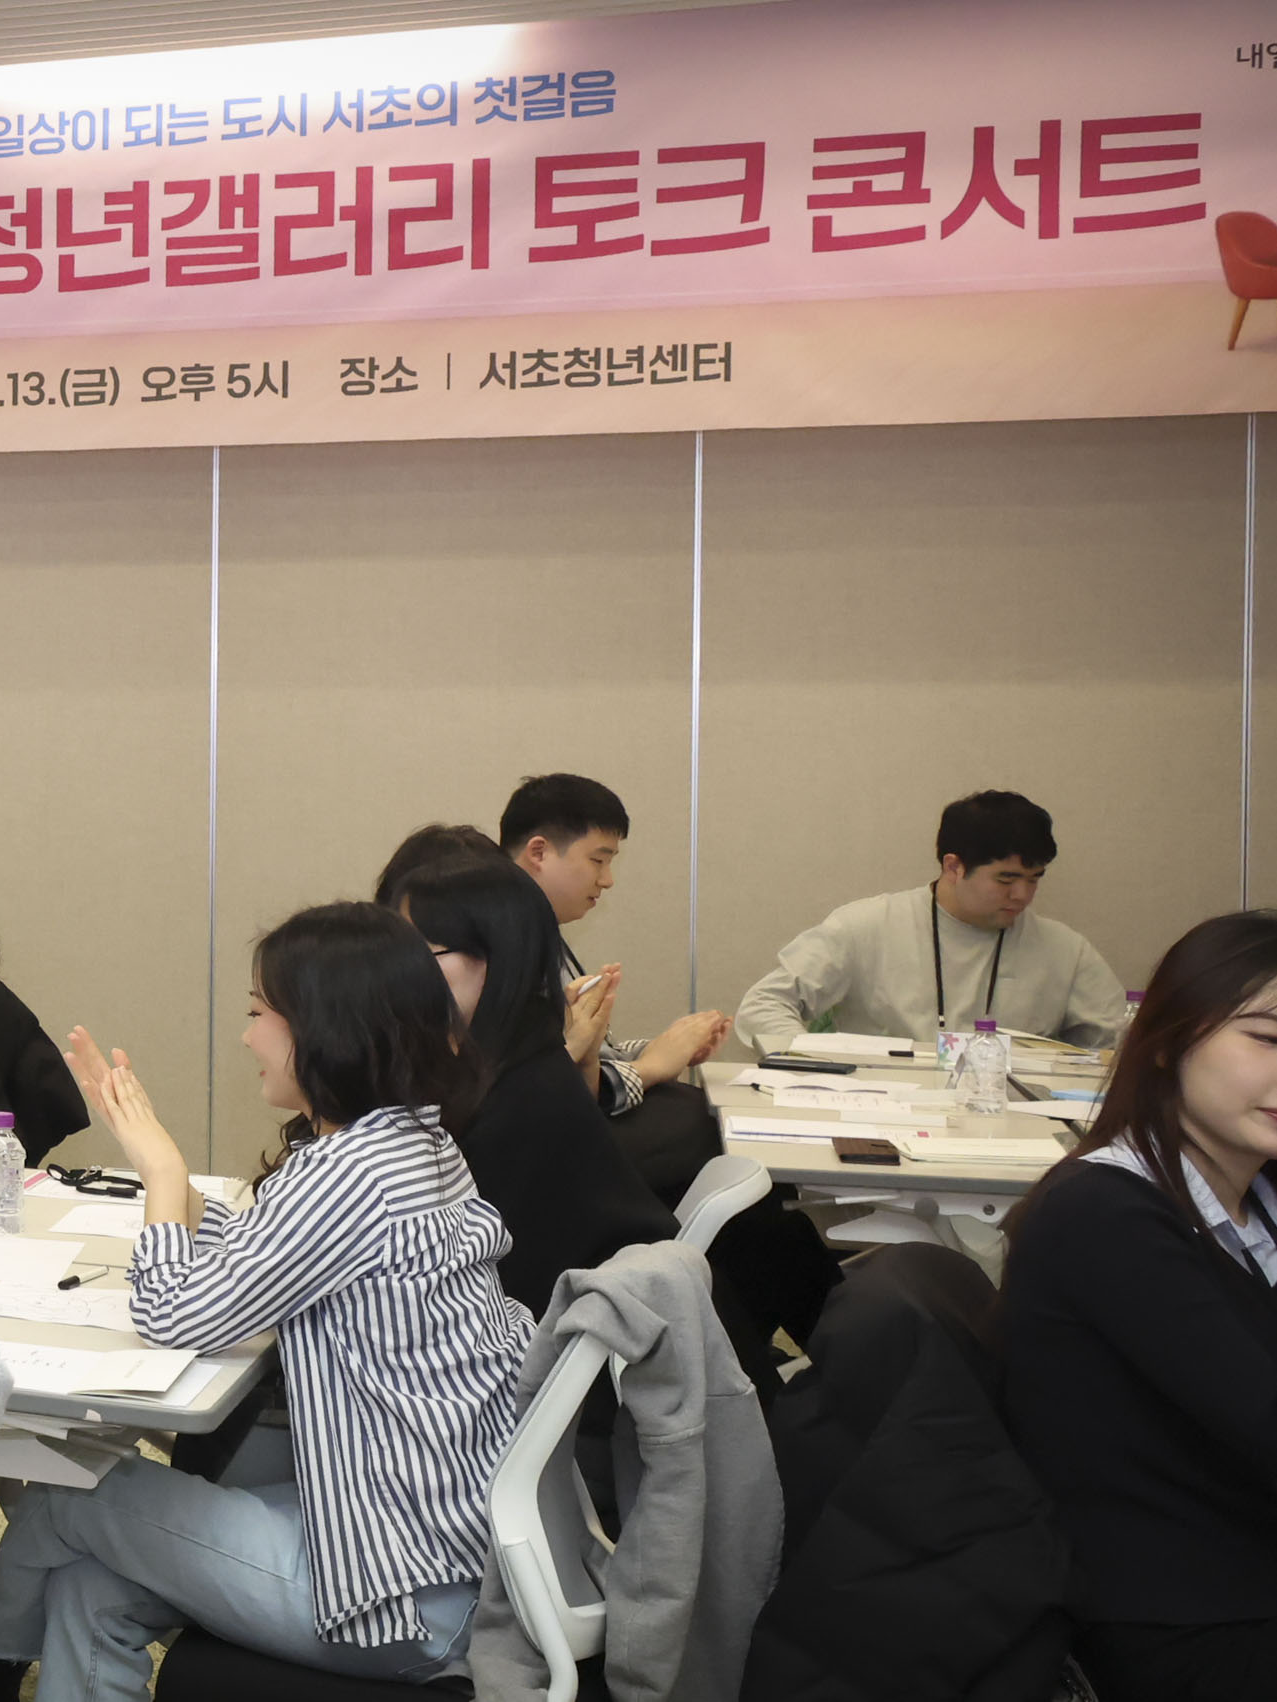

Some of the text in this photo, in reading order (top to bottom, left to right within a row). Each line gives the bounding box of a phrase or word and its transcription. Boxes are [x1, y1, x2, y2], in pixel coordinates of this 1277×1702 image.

[123, 103, 210, 149] 되는
[221, 92, 308, 141] 도시
[323, 81, 459, 134] 서초의
[474, 69, 617, 125] 첫걸음
[528, 142, 771, 263] 토크
[806, 112, 1207, 253] 콘서트
[339, 356, 419, 397] 장소
[479, 341, 733, 391] 서초청년센터
